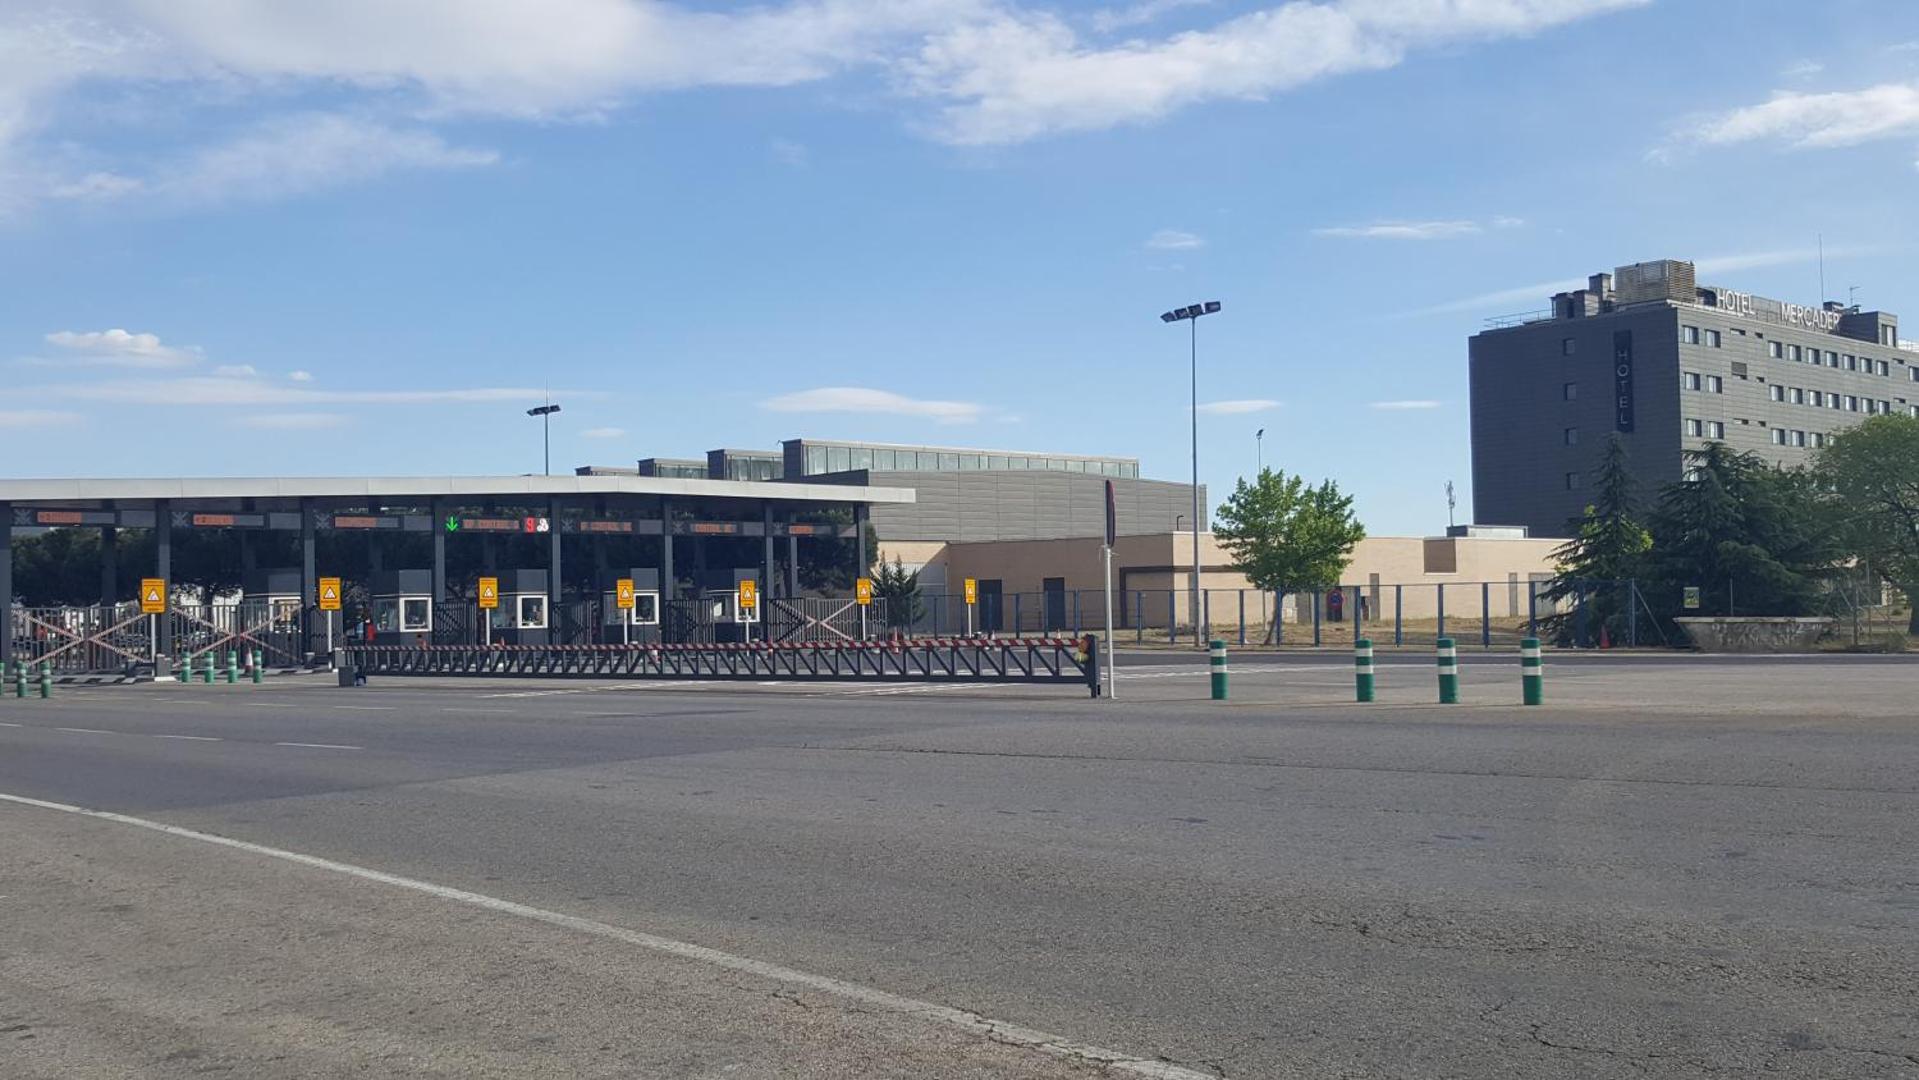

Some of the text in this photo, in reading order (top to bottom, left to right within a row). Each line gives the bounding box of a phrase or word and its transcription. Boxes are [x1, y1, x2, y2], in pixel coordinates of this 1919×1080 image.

[1716, 288, 1840, 330] HOTEL MERCADER
[1616, 350, 1630, 425] HOTEL
